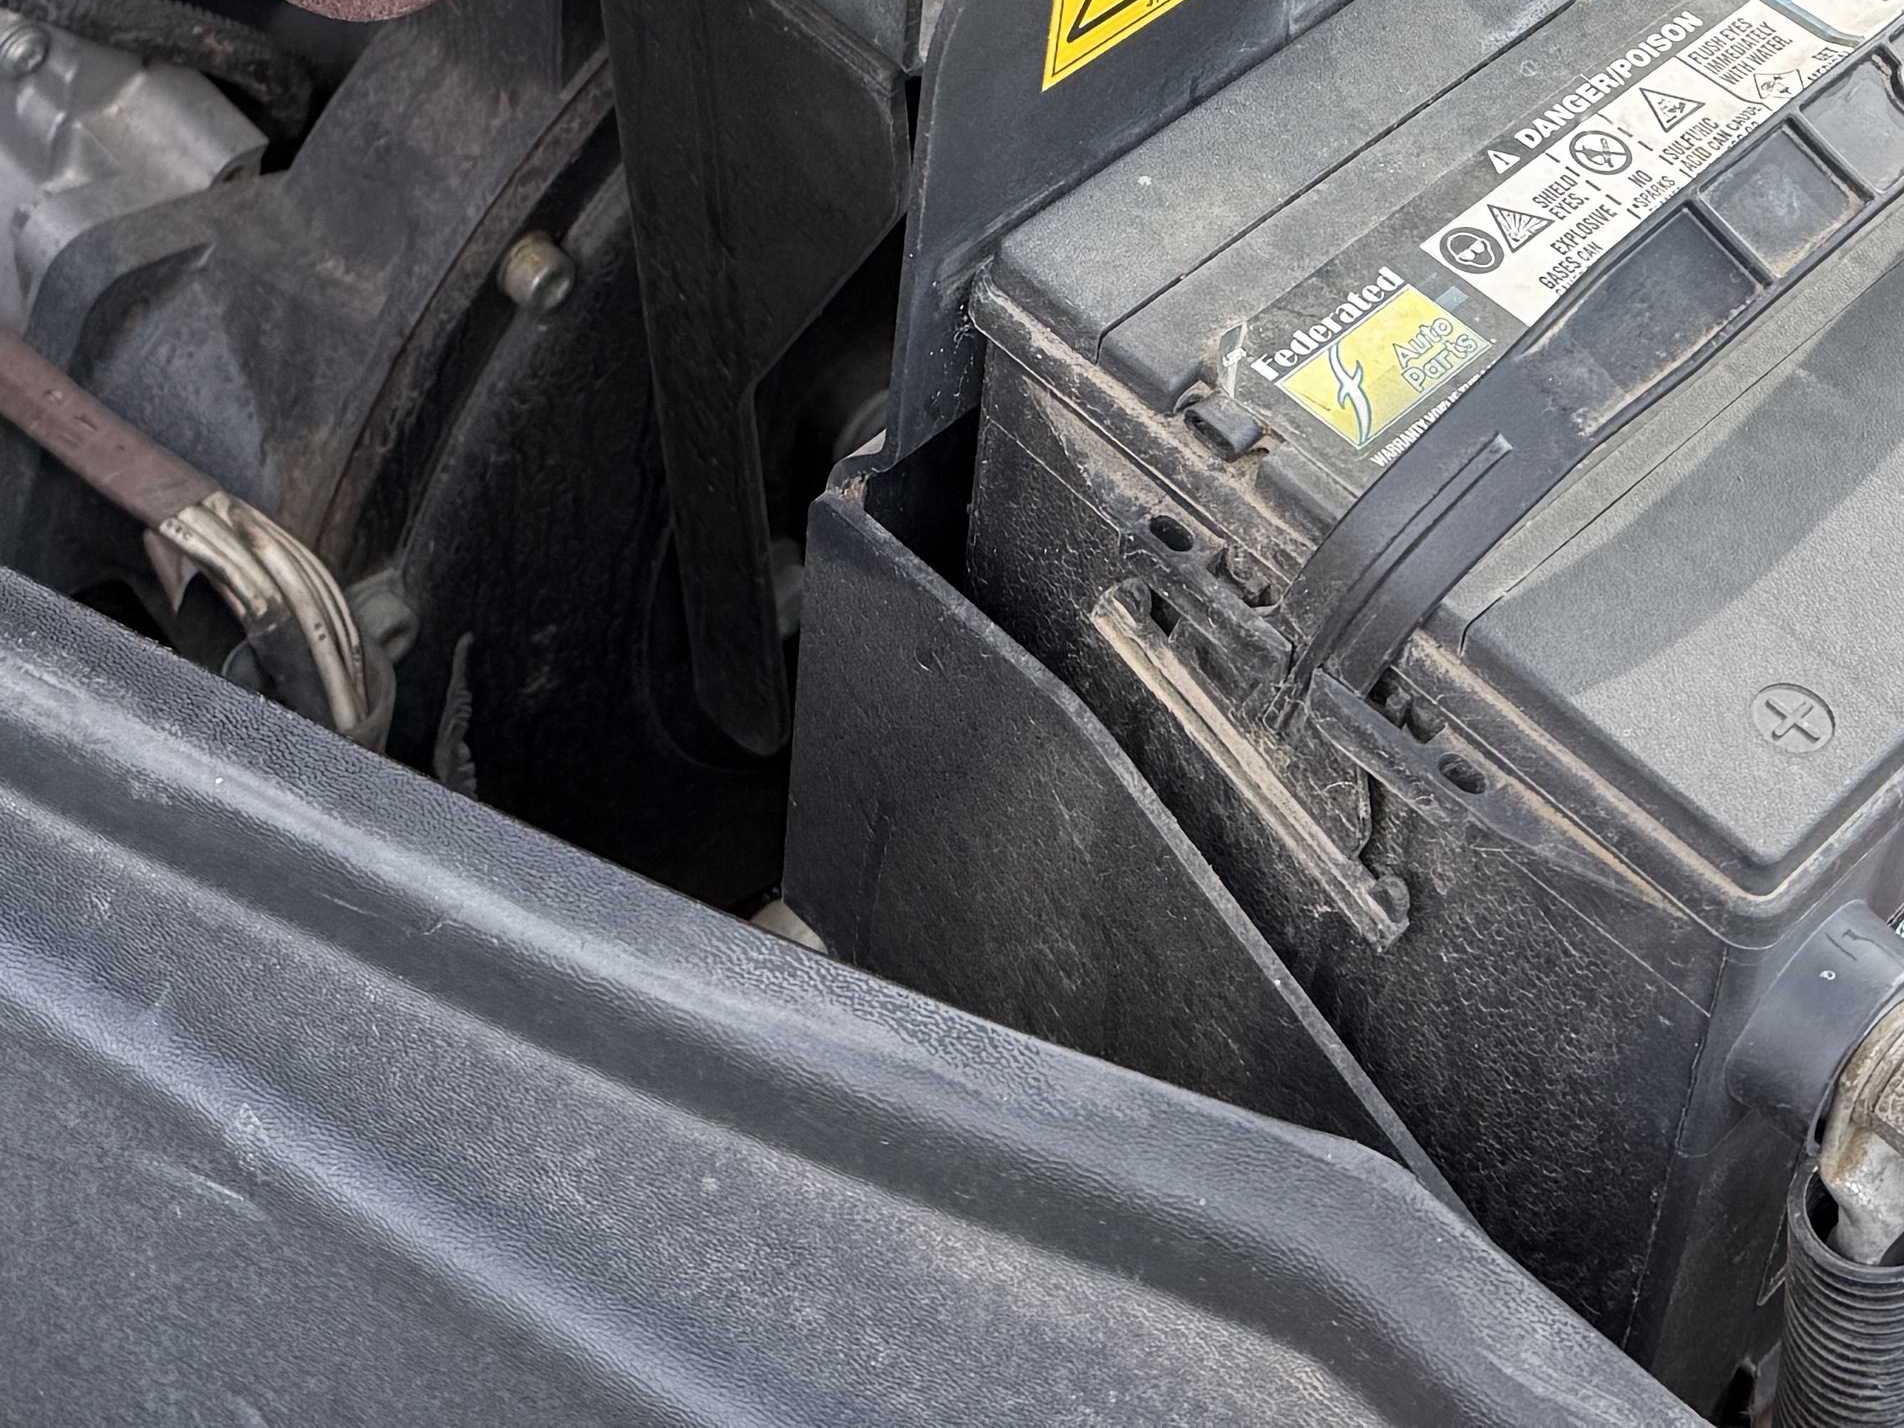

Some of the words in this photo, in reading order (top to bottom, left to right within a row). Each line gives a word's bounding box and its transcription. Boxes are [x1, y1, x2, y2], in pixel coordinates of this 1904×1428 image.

[1688, 28, 1726, 65] FLUSH
[1720, 16, 1755, 48] EYES
[1704, 20, 1778, 76] IMMEDIATELY
[1718, 55, 1755, 87] WITH
[1748, 36, 1795, 70] WATER.
[1515, 9, 1705, 149] DANGER/POISON
[1662, 117, 1720, 161] SULFURIC
[1680, 145, 1713, 172] ACID
[1707, 128, 1733, 152] CAN
[1532, 174, 1579, 209] SHIELD
[1628, 169, 1654, 189] NO
[1634, 175, 1676, 209] SPARKS
[1548, 191, 1591, 221] EYES.
[1549, 203, 1619, 256] EXPLOSIVE
[1538, 255, 1583, 290] GASES
[1577, 240, 1605, 263] CAN
[1250, 265, 1406, 382] Federated
[1391, 316, 1454, 370] Auto
[1400, 333, 1479, 394] Parts
[1369, 417, 1429, 468] WARRANTY
